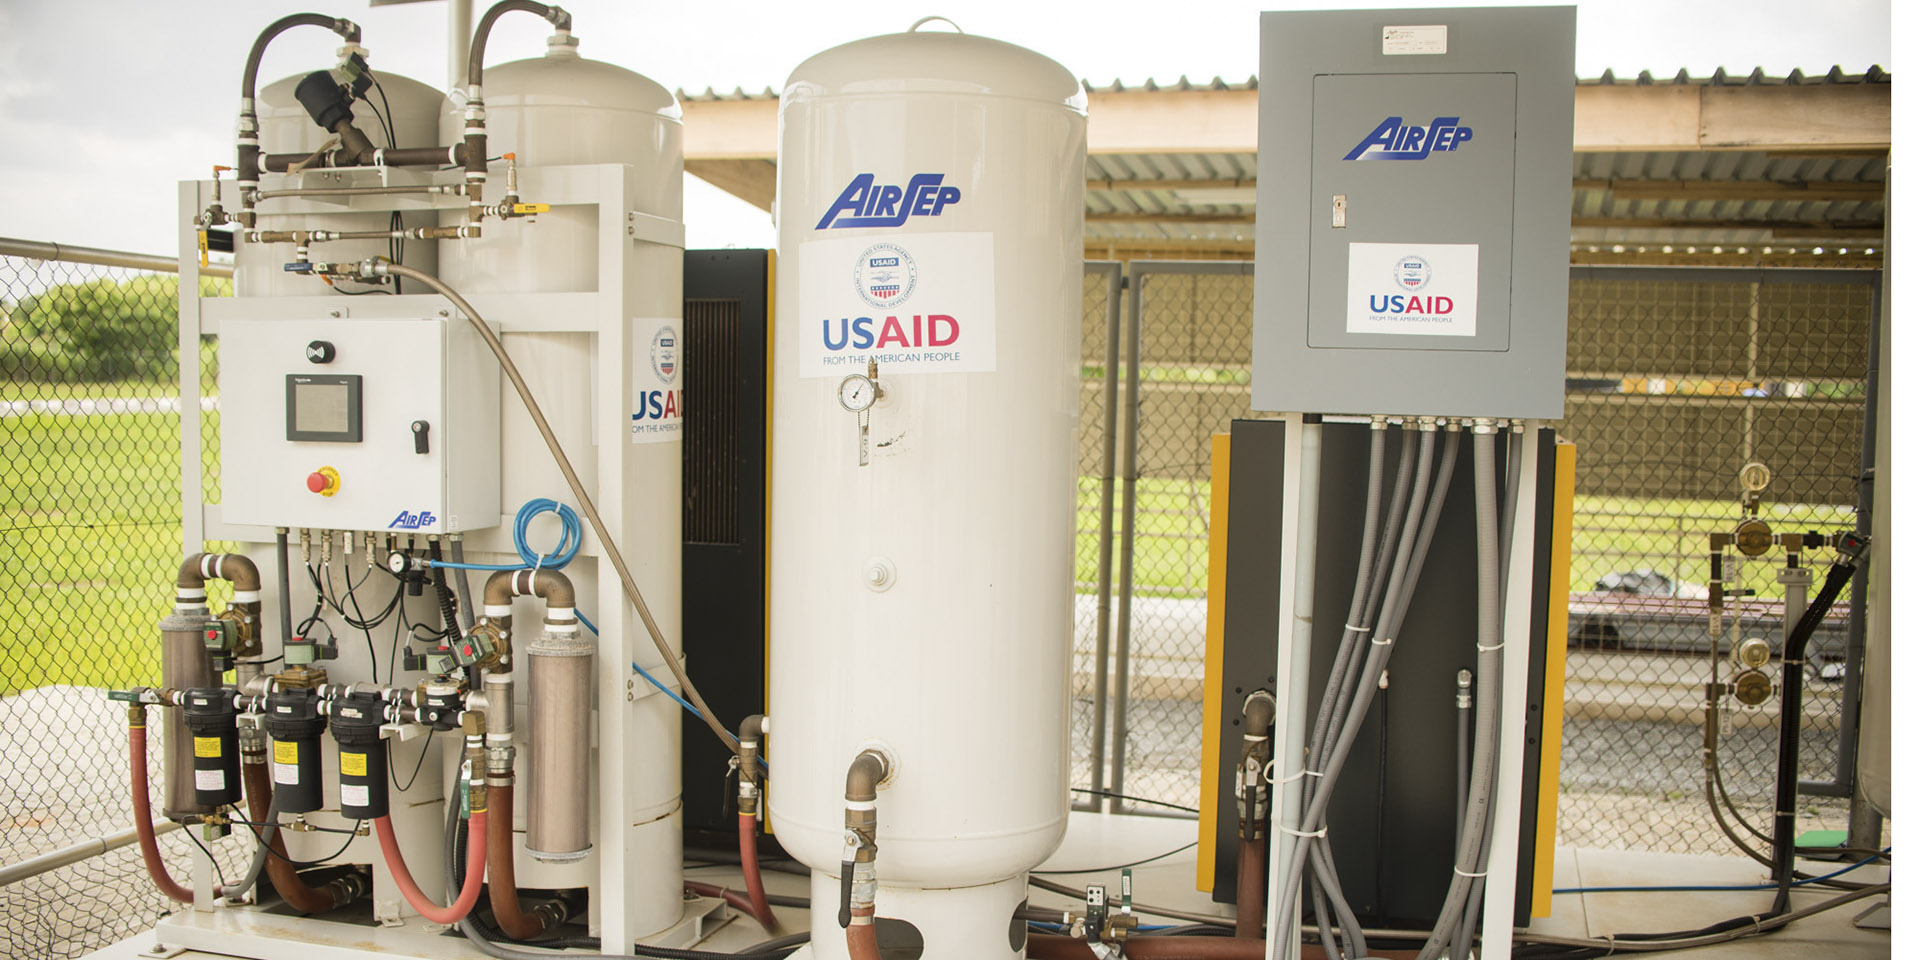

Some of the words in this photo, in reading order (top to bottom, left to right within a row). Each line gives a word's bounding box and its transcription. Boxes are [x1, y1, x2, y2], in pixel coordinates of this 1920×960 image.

[1370, 295, 1454, 314] USAID
[823, 315, 960, 351] USAID
[823, 356, 846, 366] FROM
[849, 355, 866, 364] THE
[923, 352, 960, 361] PEOPLE
[632, 390, 683, 420] USAI
[645, 424, 658, 432] THE
